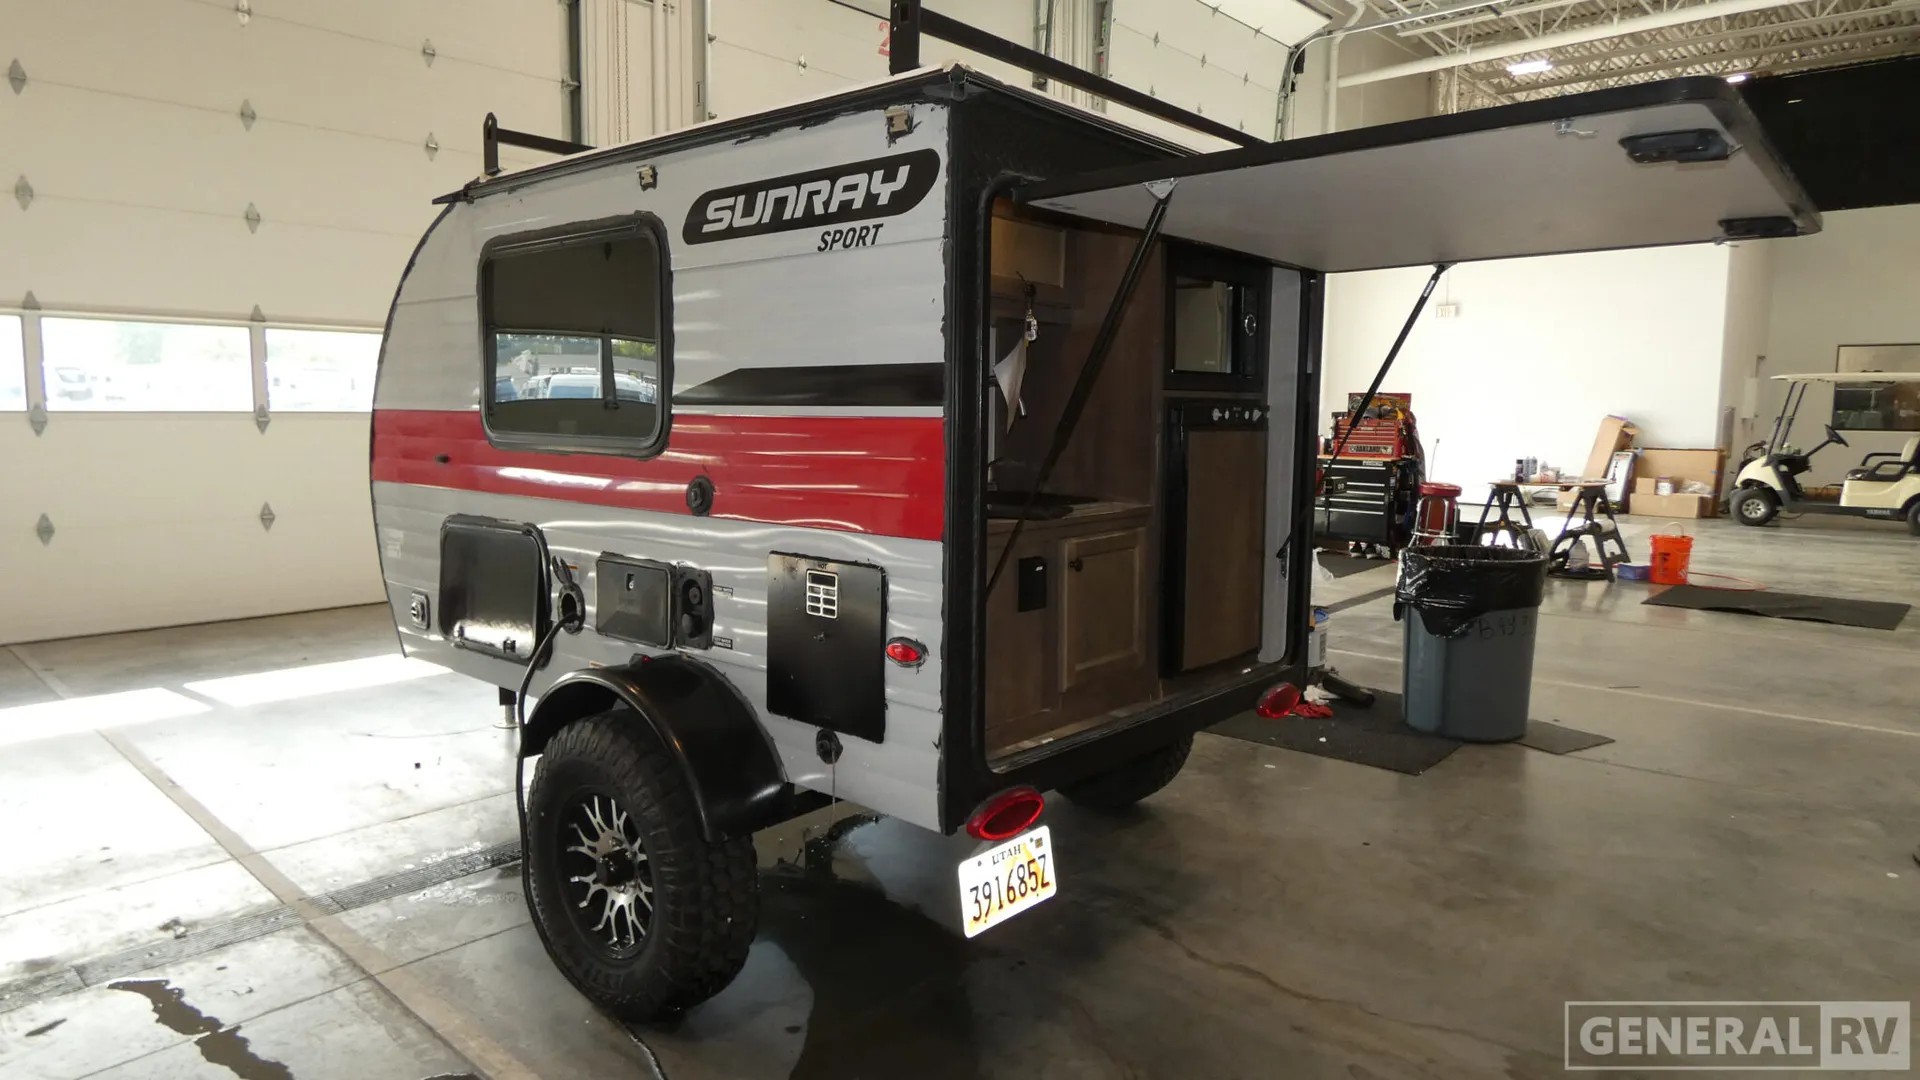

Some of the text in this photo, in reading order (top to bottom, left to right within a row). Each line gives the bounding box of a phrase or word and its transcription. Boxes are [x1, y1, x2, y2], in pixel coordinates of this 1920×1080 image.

[702, 165, 911, 233] SUNRAY
[817, 223, 884, 252] SPORT
[991, 844, 1022, 866] UTAH
